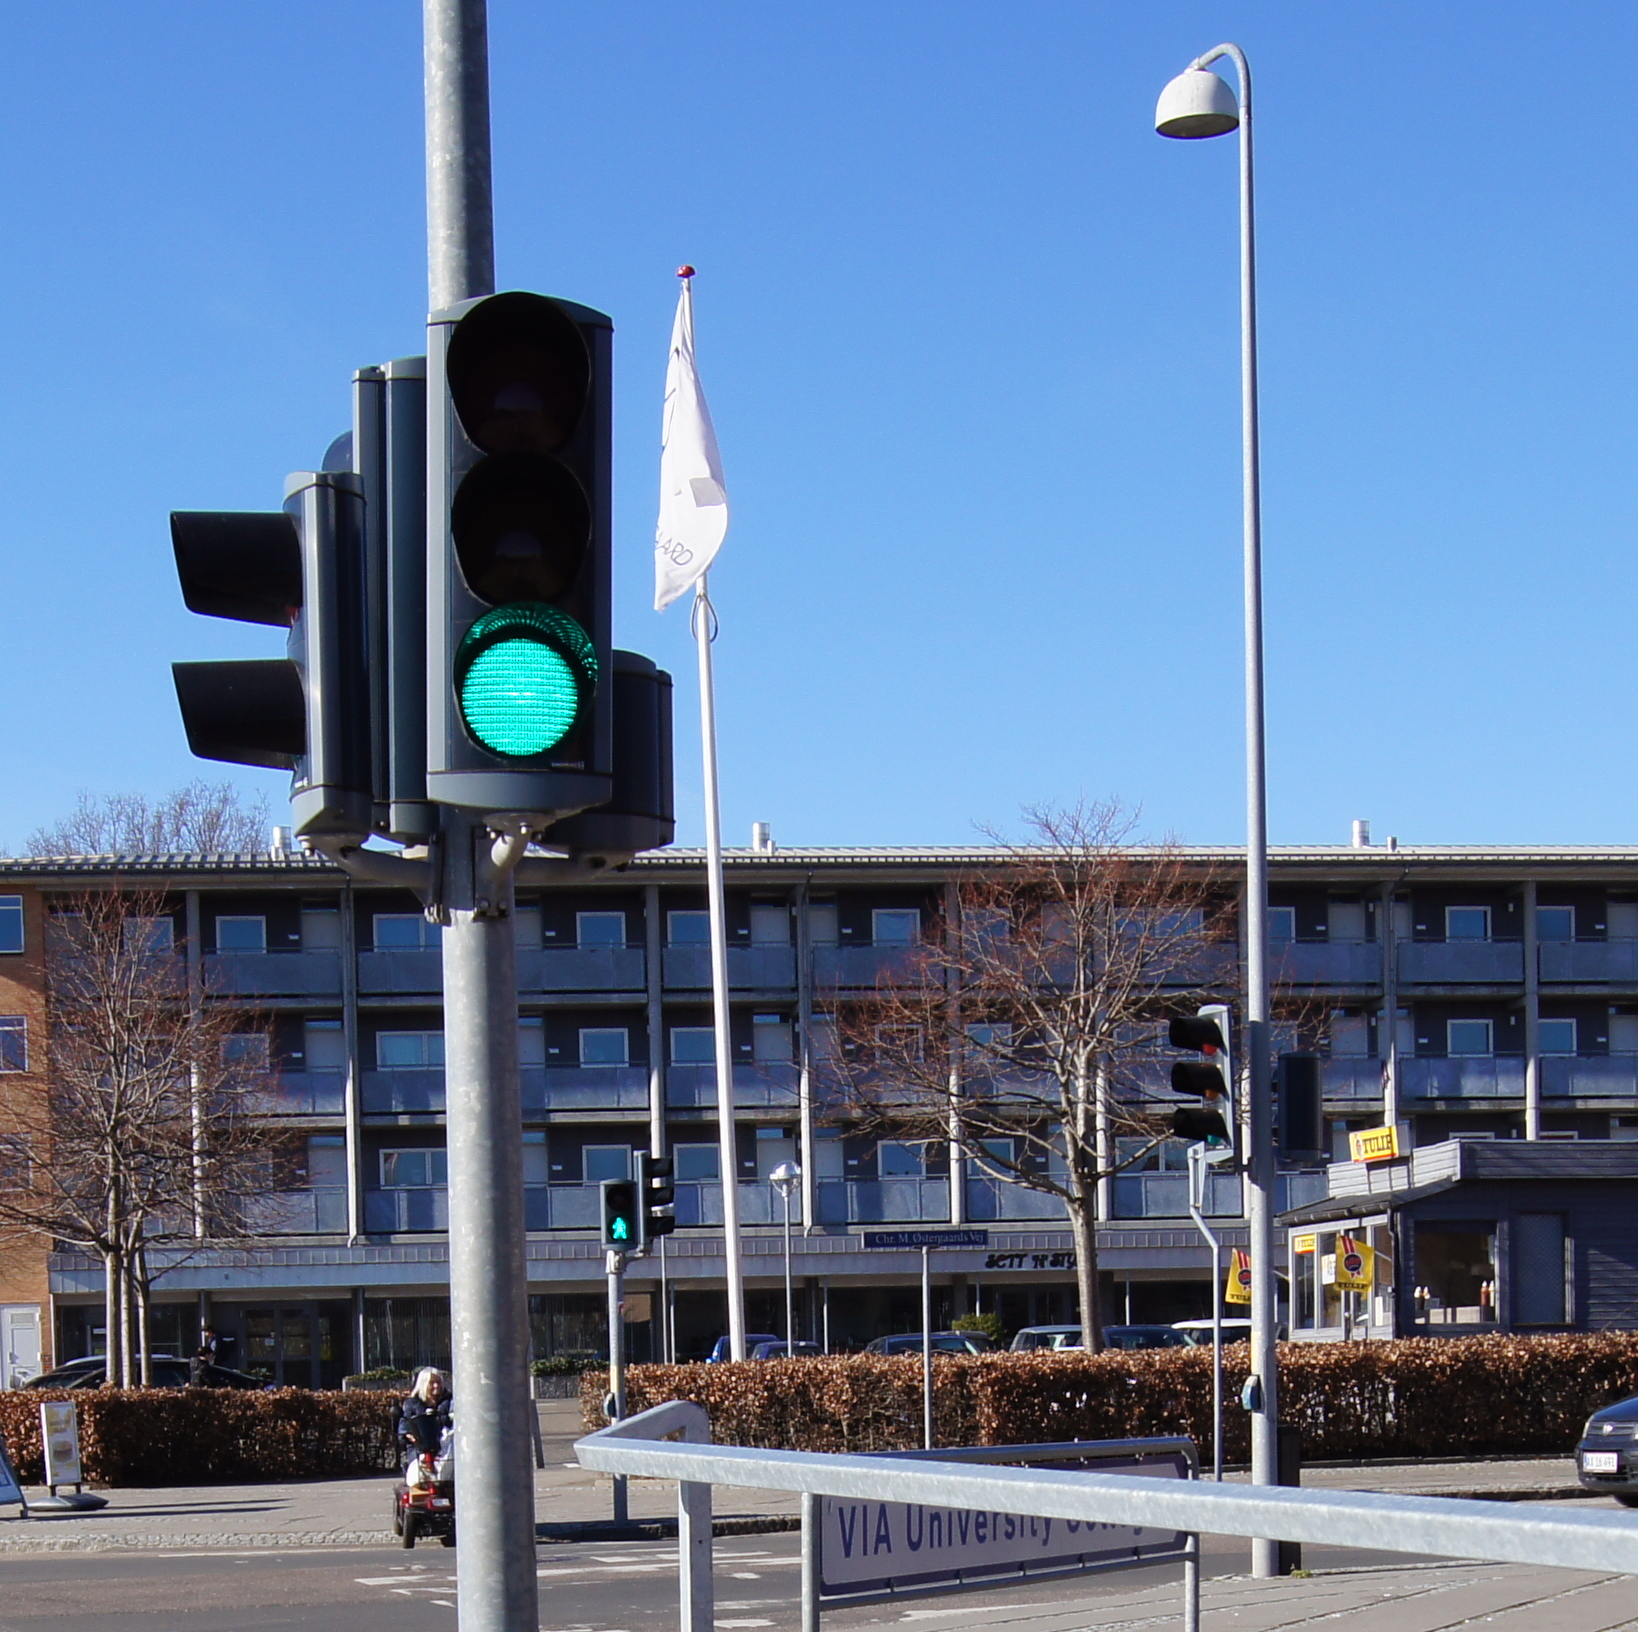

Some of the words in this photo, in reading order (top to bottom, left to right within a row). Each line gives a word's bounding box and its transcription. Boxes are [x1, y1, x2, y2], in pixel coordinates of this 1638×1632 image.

[875, 1233, 896, 1244] Chr.
[898, 1233, 911, 1244] M.
[913, 1231, 968, 1244] Østergaards
[969, 1231, 984, 1243] Vej
[838, 1503, 892, 1559] VIA
[906, 1503, 1053, 1553] University
